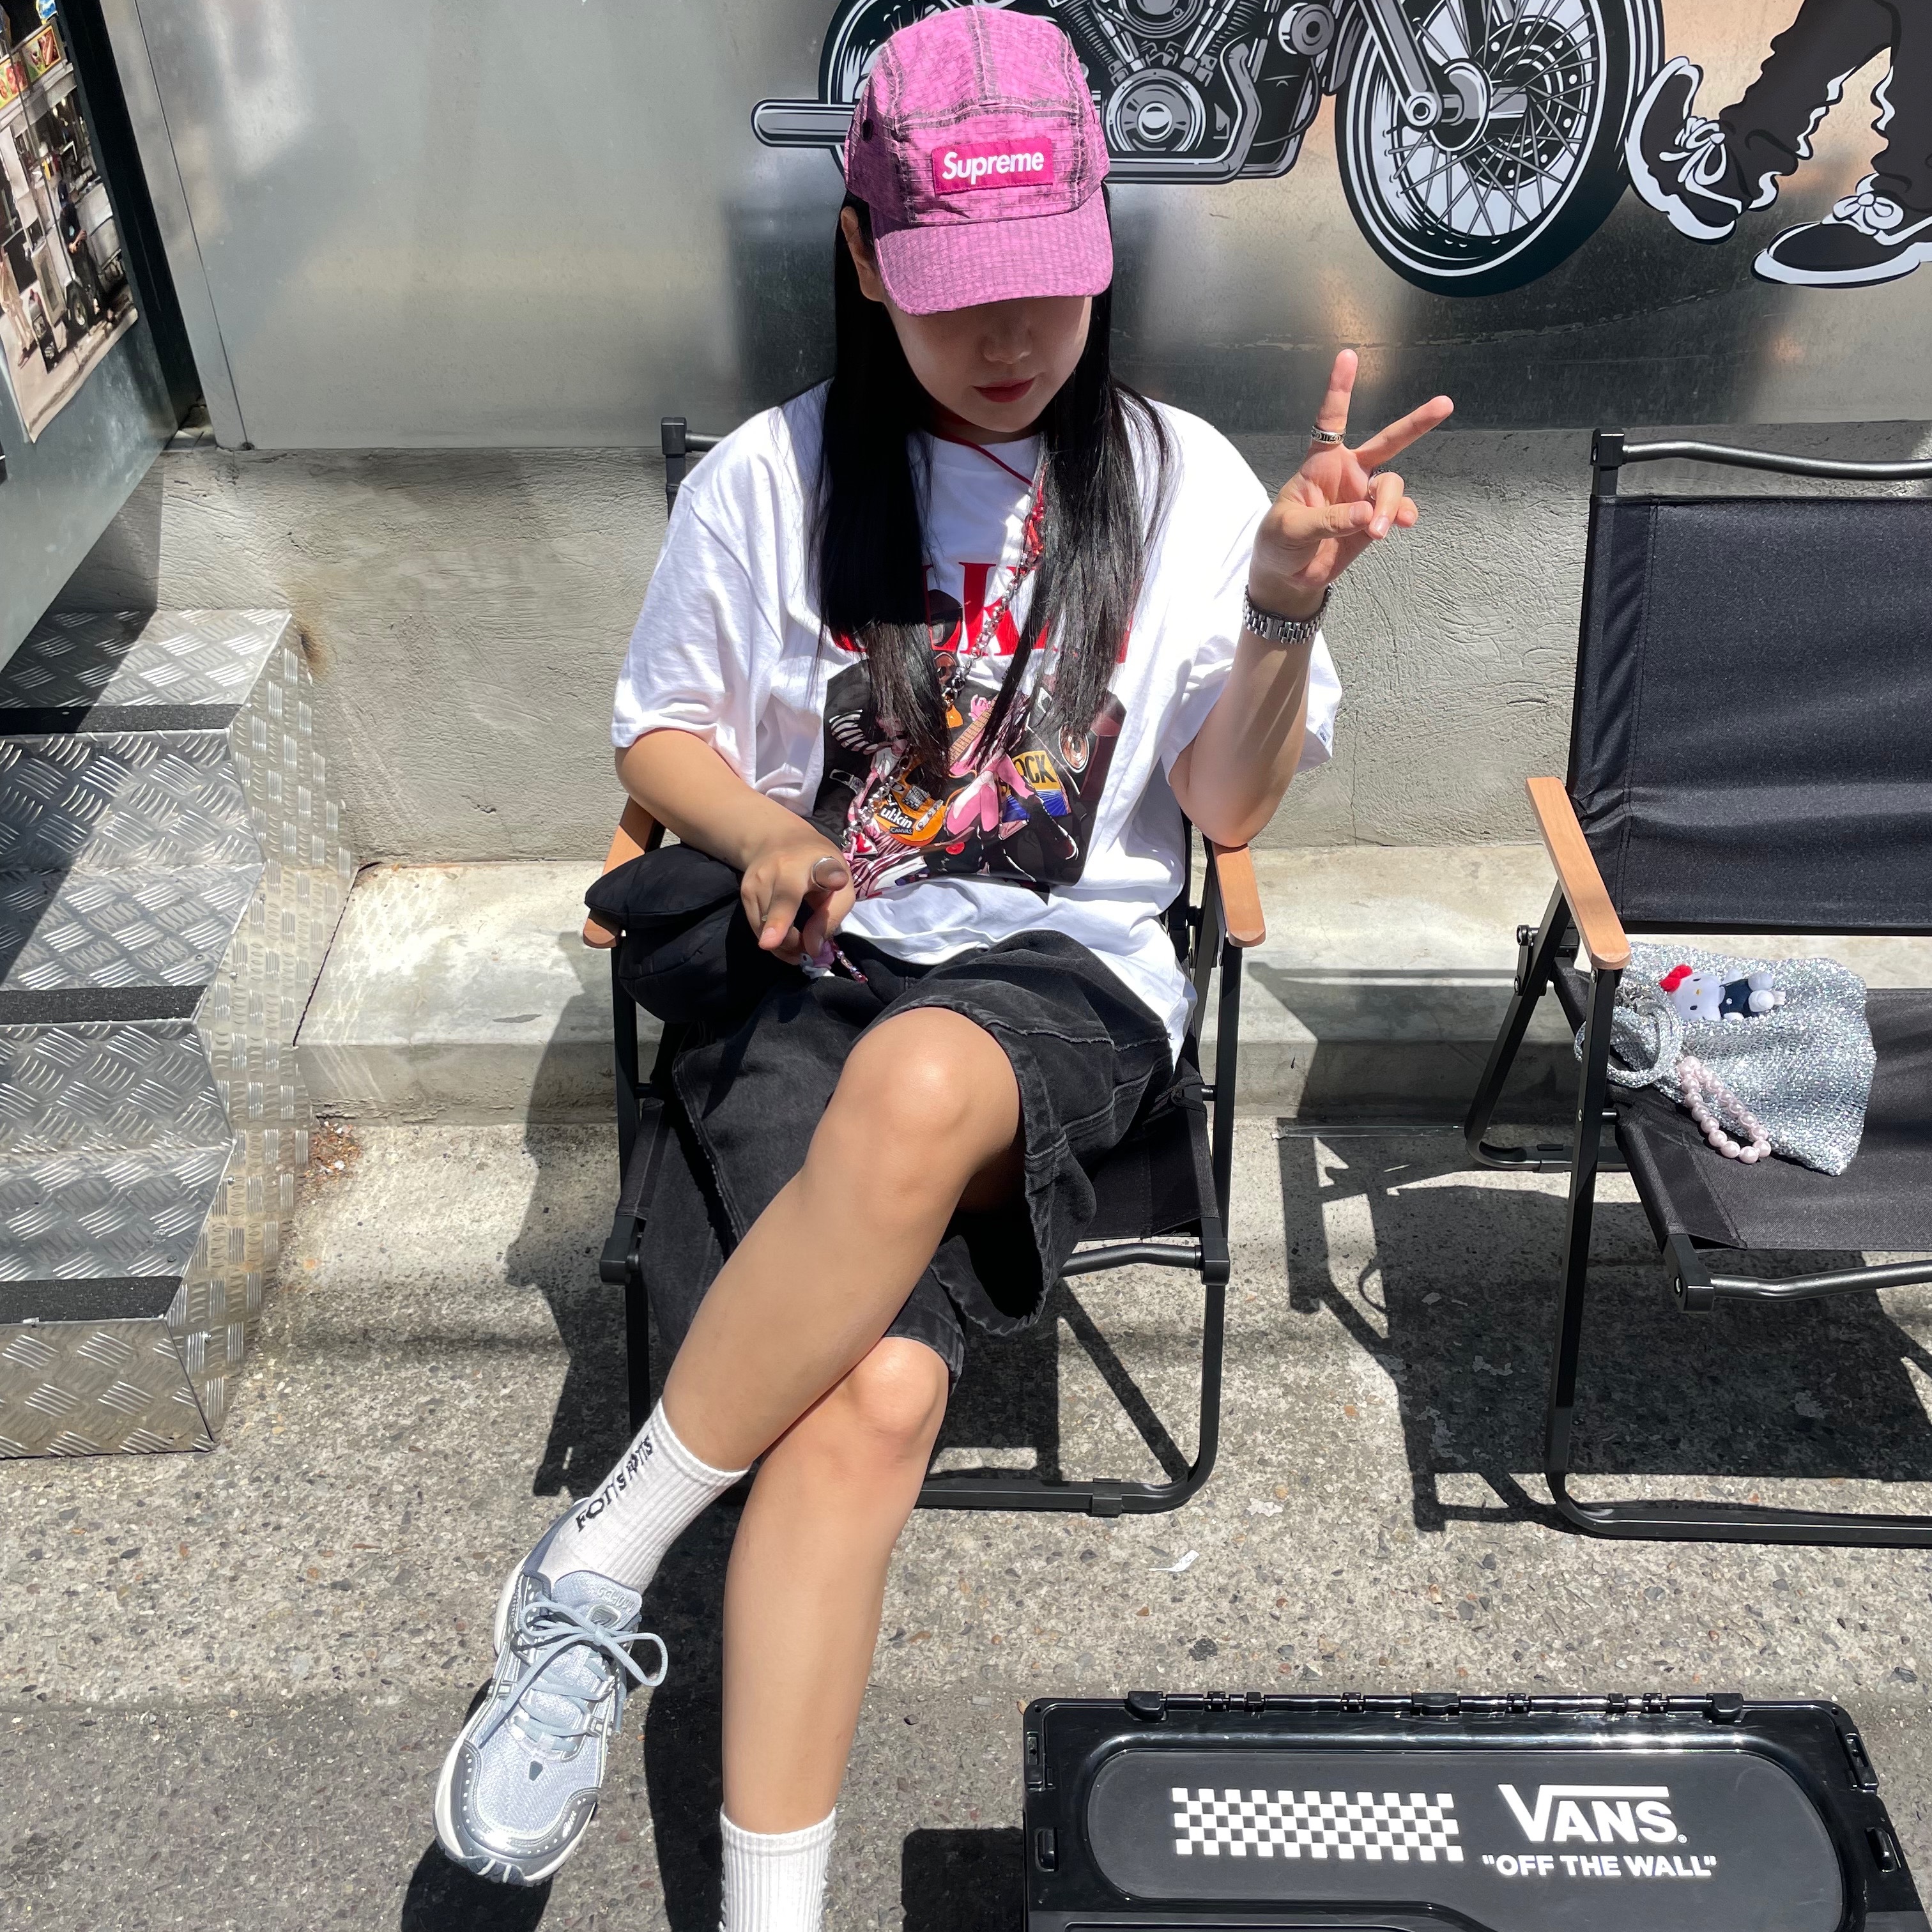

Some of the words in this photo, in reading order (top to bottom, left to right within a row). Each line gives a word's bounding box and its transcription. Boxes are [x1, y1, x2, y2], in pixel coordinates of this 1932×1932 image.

[942, 151, 1045, 185] Supreme
[1498, 1784, 1678, 1843] VANS
[1482, 1855, 1554, 1876] "OFF
[1560, 1855, 1621, 1876] THE
[1623, 1855, 1717, 1876] WALL"
